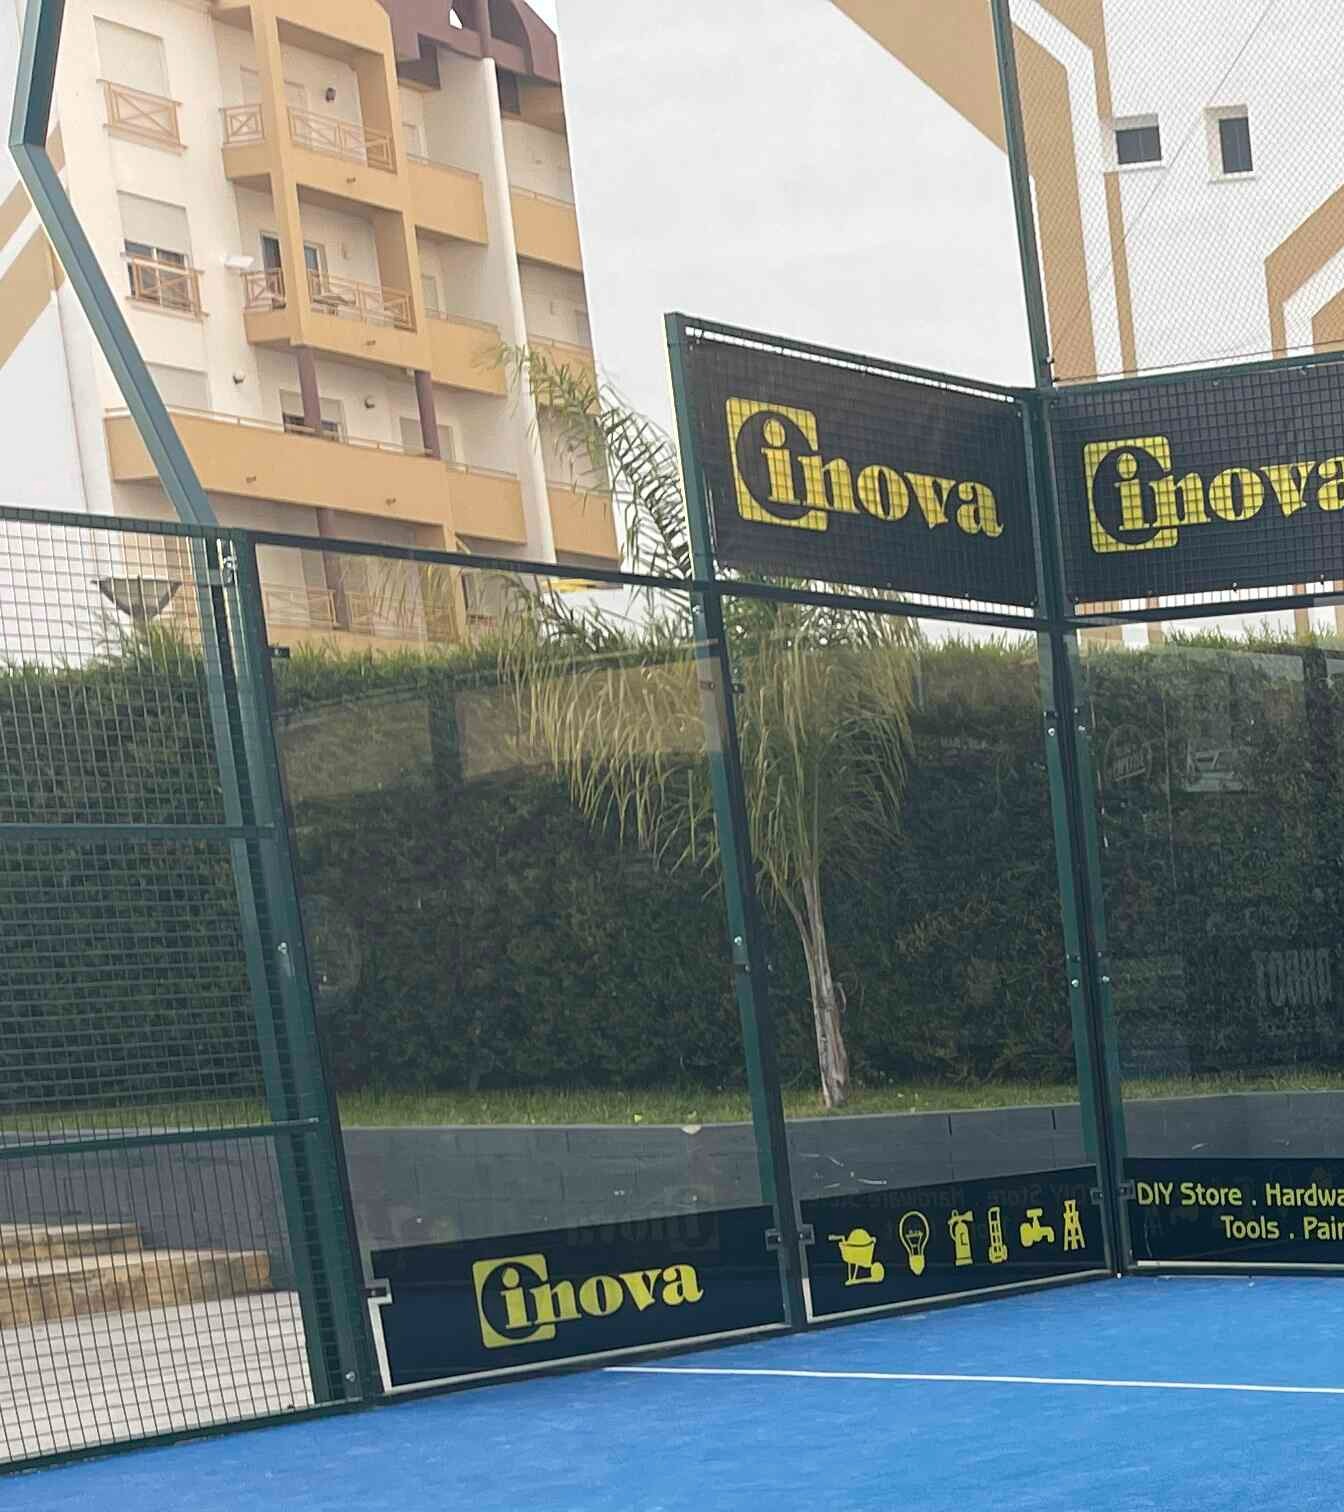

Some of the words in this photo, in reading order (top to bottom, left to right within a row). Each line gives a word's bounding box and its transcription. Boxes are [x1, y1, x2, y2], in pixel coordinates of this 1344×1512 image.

[1136, 1182, 1173, 1205] DIY
[1180, 1182, 1243, 1206] Store
[1221, 1215, 1280, 1240] Tools
